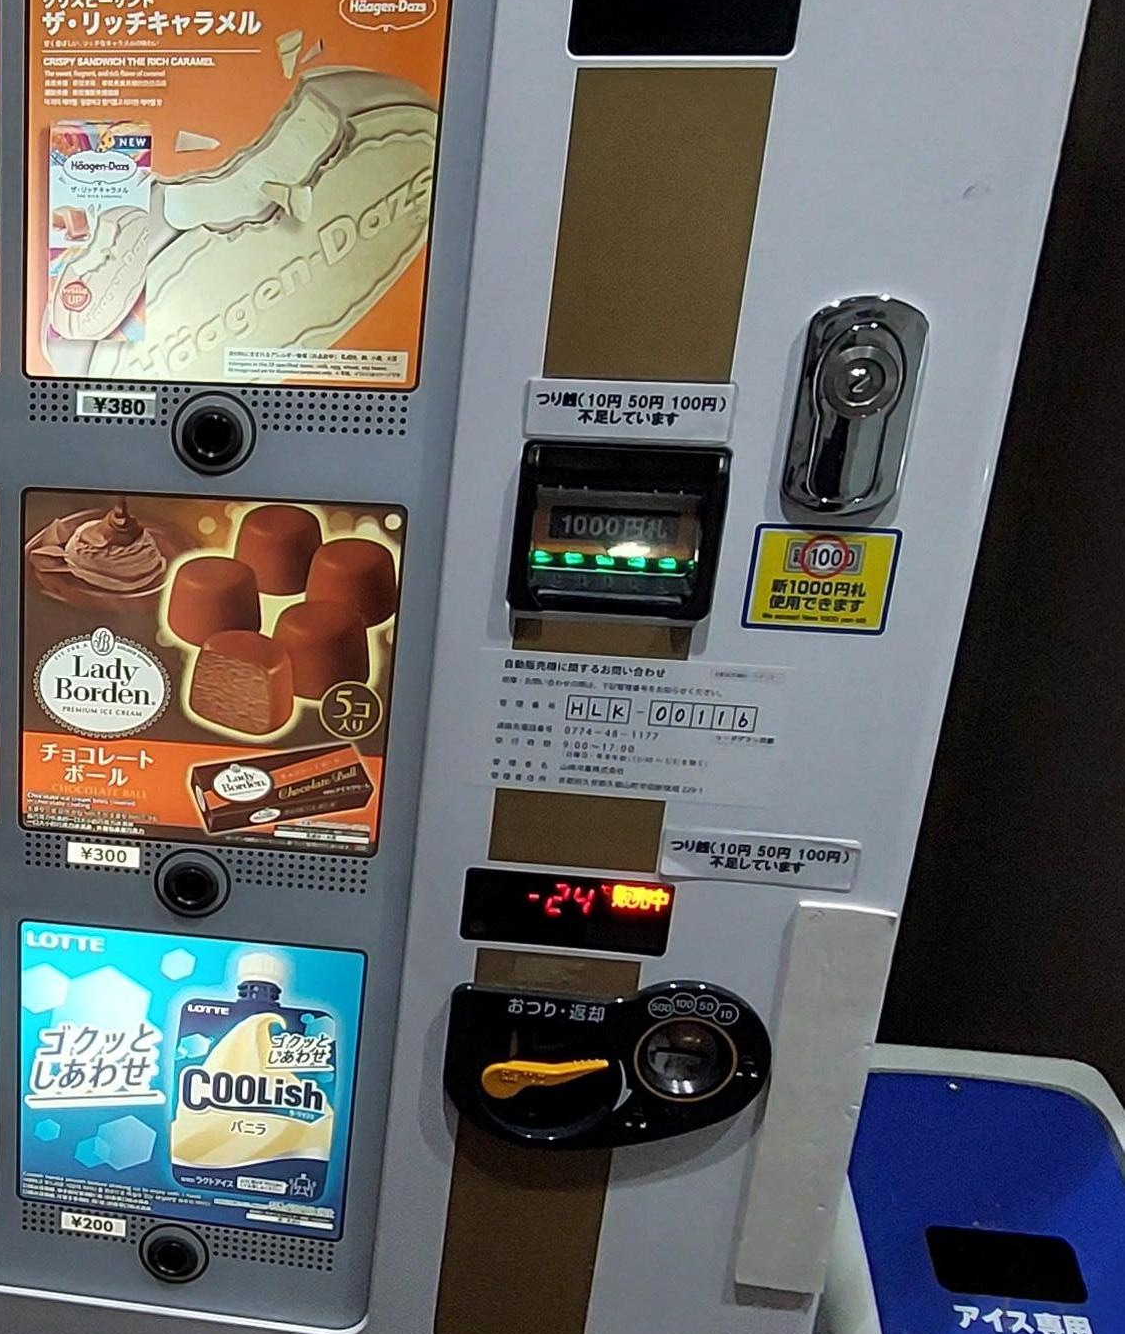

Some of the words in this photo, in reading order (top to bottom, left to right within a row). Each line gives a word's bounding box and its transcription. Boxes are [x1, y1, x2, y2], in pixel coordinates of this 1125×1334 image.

[349, 0, 427, 14] Häagen-Dazs
[42, 10, 262, 37] ザ・リッチキャラメル
[43, 57, 76, 67] CRISPY
[77, 57, 126, 66] SANDWICH
[127, 57, 146, 66] THE
[147, 57, 170, 66] RICH
[170, 57, 215, 66] CARAMEL
[119, 138, 146, 147] NEW
[70, 160, 130, 173] Häagen-Dazs
[93, 396, 146, 415] ¥380
[628, 394, 664, 410] 50円
[578, 409, 679, 427] 不足しています
[562, 514, 666, 538] 1000円札
[771, 579, 866, 597] 新1000円札
[769, 595, 865, 612] 使用できます
[72, 655, 141, 686] Lady
[53, 677, 150, 706] Borden
[333, 690, 370, 719] 5コ
[571, 702, 624, 719] HLK
[339, 718, 363, 733] 入り
[40, 743, 154, 769] チョコレート
[65, 767, 129, 787] ボール
[226, 771, 255, 784] Lady
[221, 779, 267, 793] Borden
[278, 777, 330, 800] Chocolate
[81, 847, 127, 864] ¥300
[757, 845, 791, 859] 50円
[710, 857, 806, 874] 不足しています
[26, 930, 105, 952] LOTTE
[188, 1004, 229, 1015] LOTTE
[508, 998, 606, 1022] おつり・返却
[652, 1002, 672, 1013] 500
[675, 999, 694, 1010] 100
[700, 1001, 713, 1011] 50
[720, 1009, 732, 1020] 10
[40, 1023, 154, 1056] ゴクッと
[270, 1034, 327, 1049] ゴクッと
[268, 1049, 326, 1064] しあわせ
[35, 1058, 150, 1090] しあわせ
[231, 1120, 266, 1135] バニラ
[195, 1176, 234, 1187] ラクトアイス
[70, 1215, 113, 1232] ¥200
